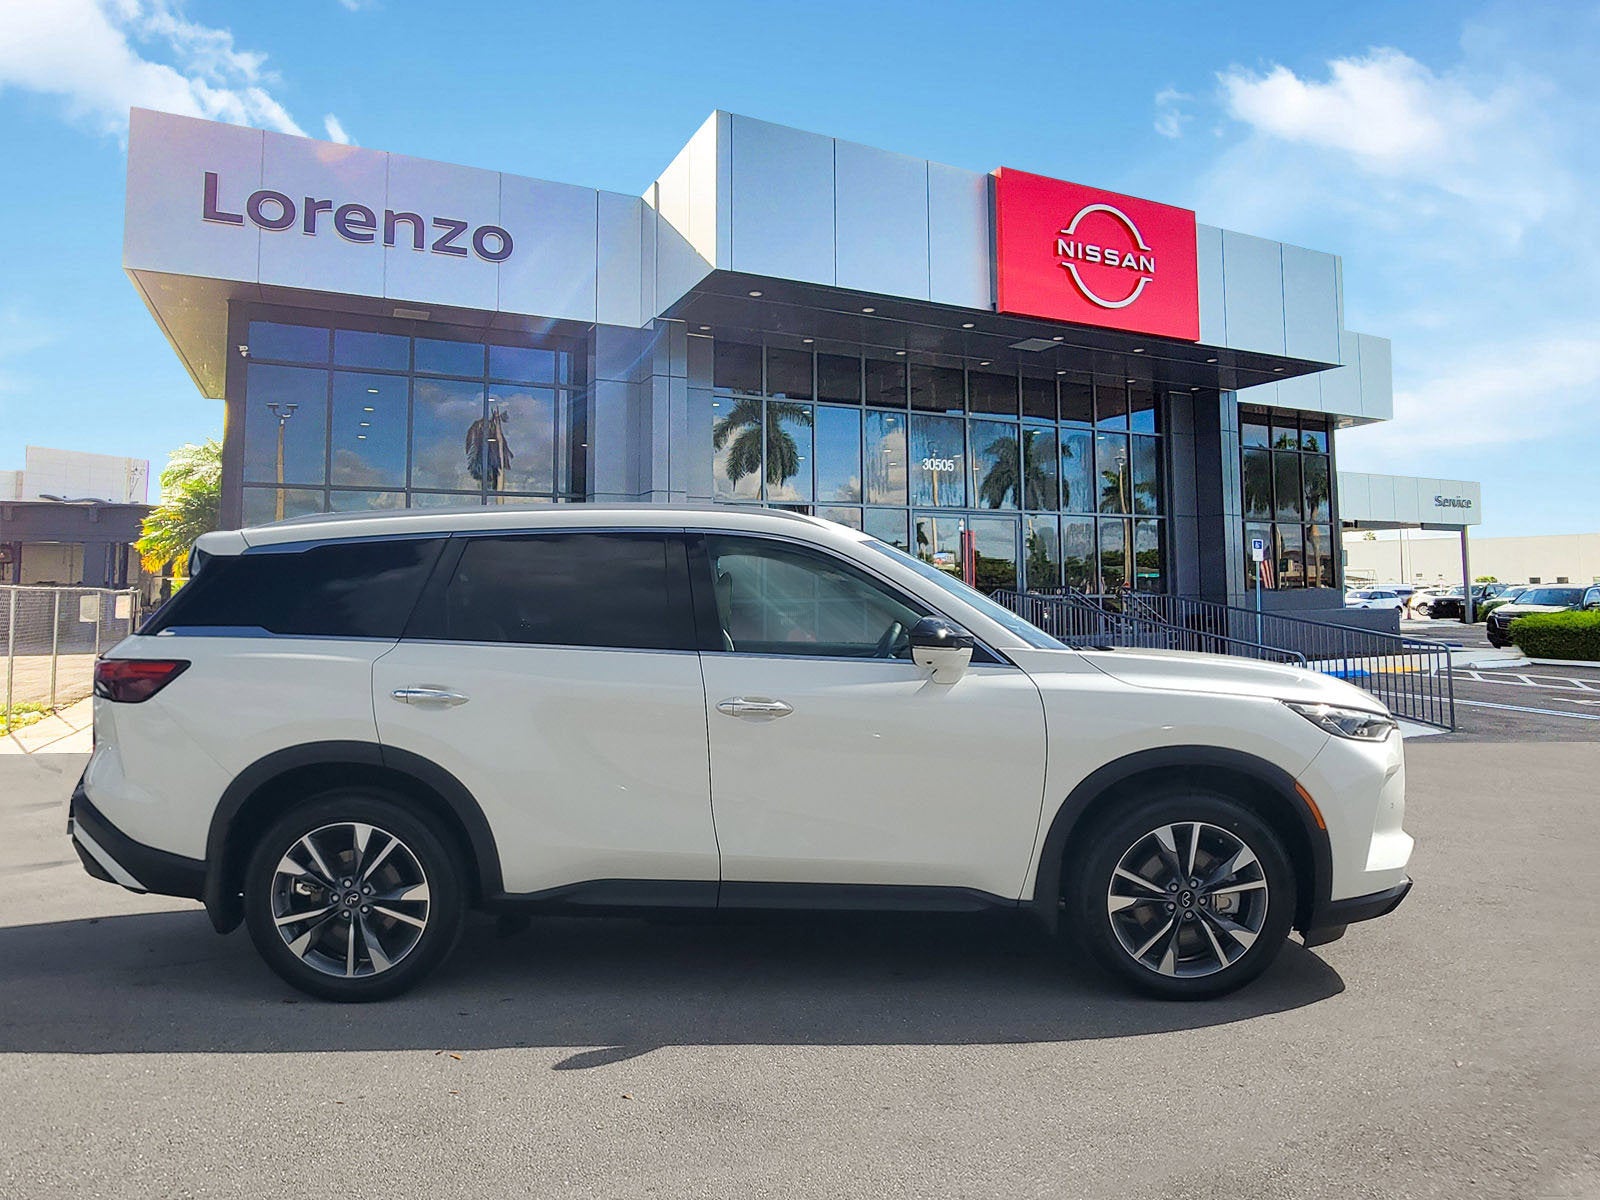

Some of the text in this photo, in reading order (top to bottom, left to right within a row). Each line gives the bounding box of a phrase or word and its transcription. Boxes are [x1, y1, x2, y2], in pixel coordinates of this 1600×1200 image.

[203, 171, 514, 262] Lorenzo
[1057, 238, 1155, 273] NISSAN
[922, 458, 955, 472] 30505
[1434, 495, 1472, 509] Service
